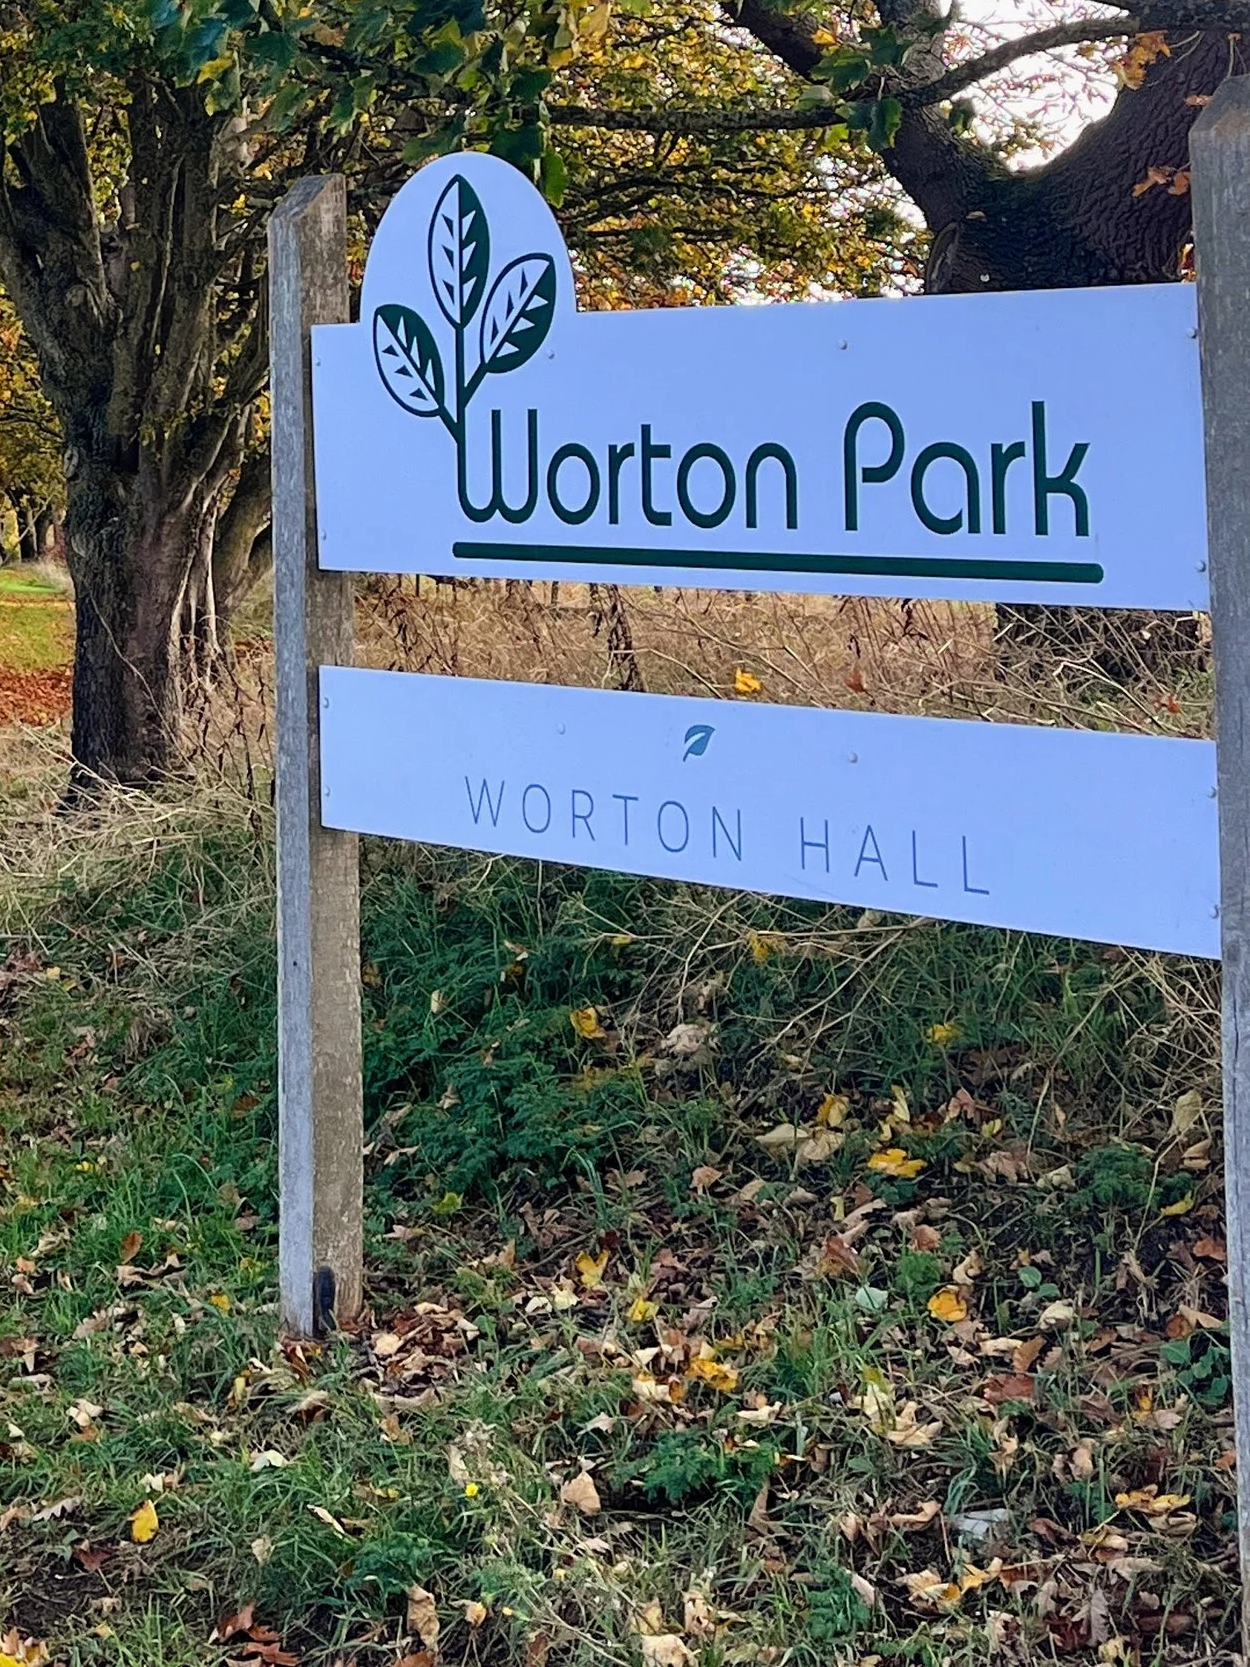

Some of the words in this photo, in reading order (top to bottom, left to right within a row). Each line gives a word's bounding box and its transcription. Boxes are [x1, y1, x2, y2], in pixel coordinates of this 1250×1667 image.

[456, 408, 798, 529] Worton
[844, 401, 1091, 537] Park
[465, 776, 744, 861] WORTON
[800, 816, 990, 895] HALL
